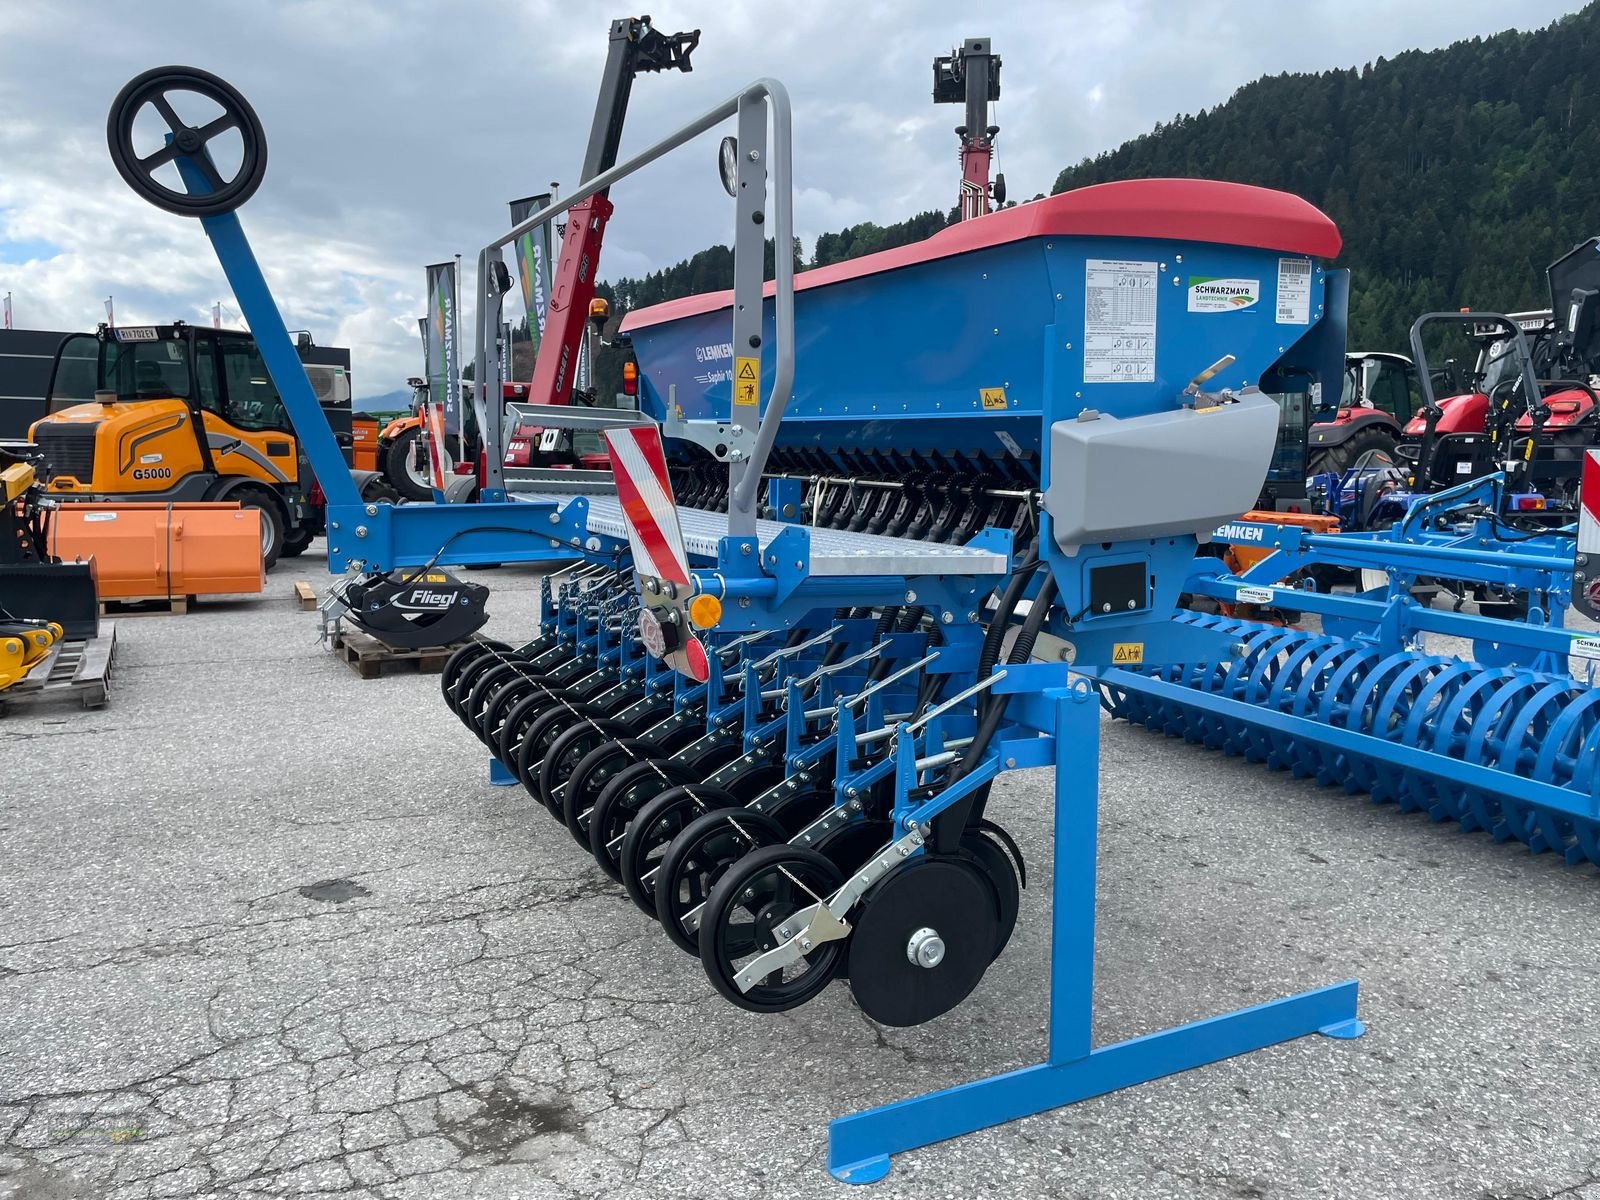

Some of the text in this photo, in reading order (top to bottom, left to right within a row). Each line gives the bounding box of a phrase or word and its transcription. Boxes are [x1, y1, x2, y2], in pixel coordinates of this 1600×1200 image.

[1195, 285, 1250, 295] SCHWARZMAYR
[702, 343, 734, 361] LEMKEN
[708, 369, 725, 384] Saphir
[133, 467, 171, 480] G5000
[409, 590, 459, 607] Fliegl
[1576, 639, 1600, 648] SCHWA
